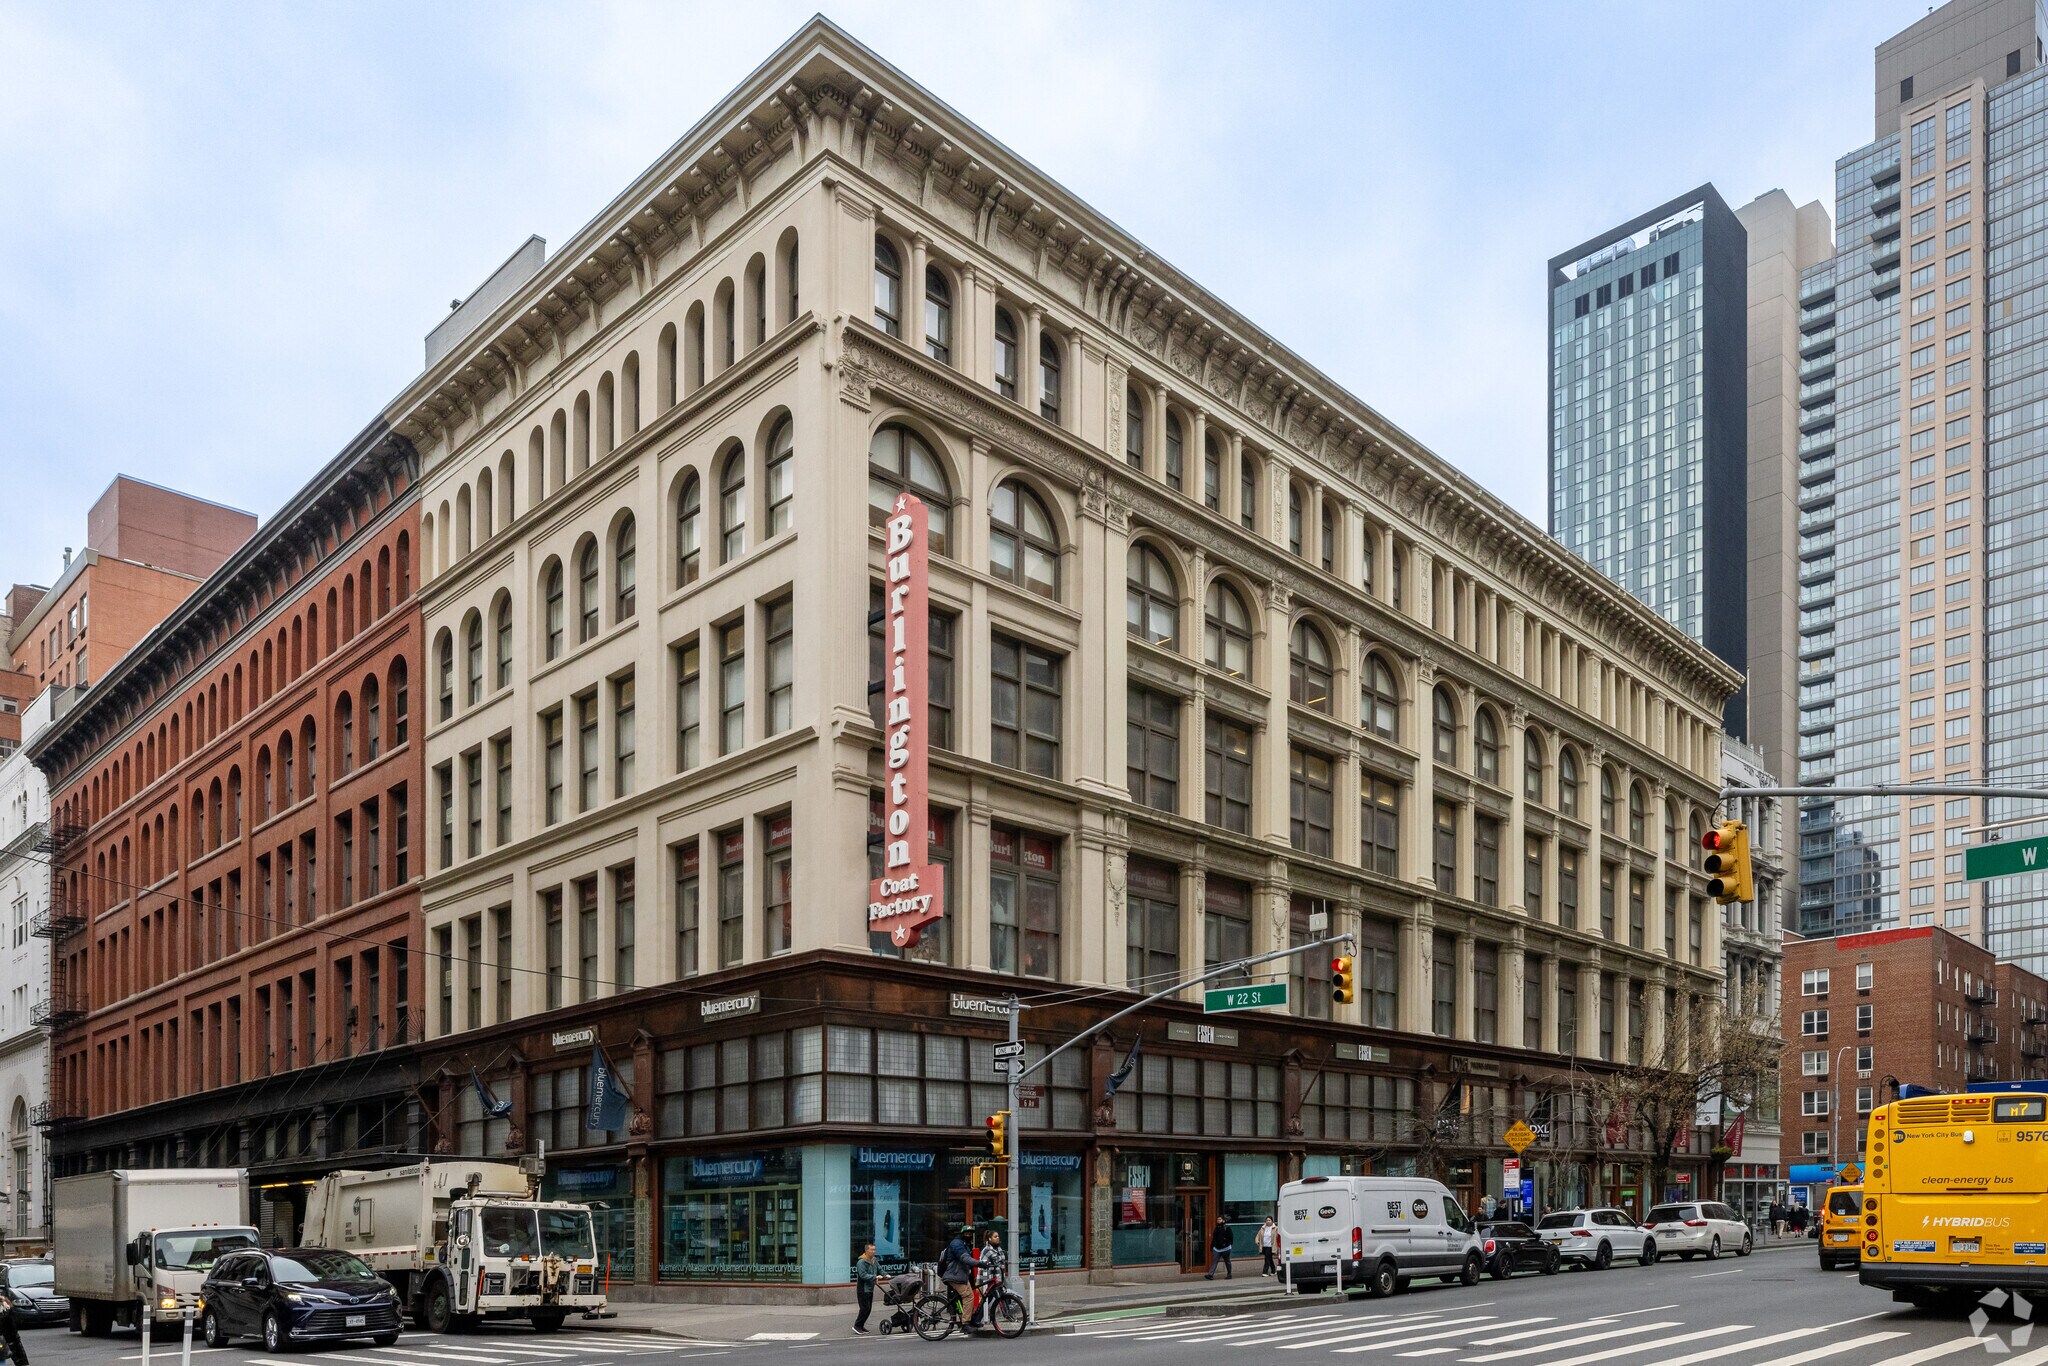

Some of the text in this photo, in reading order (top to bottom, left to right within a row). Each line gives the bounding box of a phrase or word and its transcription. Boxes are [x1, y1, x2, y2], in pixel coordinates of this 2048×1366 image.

[887, 514, 914, 868] Burlington
[880, 873, 919, 897] Coat
[869, 894, 933, 921] Factory
[701, 995, 756, 1016] bluemercury
[1227, 992, 1261, 1006] W 22 St
[552, 1029, 594, 1047] bluemercury
[1197, 1024, 1215, 1044] ESSEN
[998, 1046, 1007, 1055] ONE
[860, 1148, 936, 1168] bluemercury
[1021, 1152, 1081, 1169] bluemercury
[400, 1167, 420, 1176] sanitation
[692, 1157, 758, 1180] bluemercury
[1128, 1165, 1151, 1188] ESSEN
[1922, 1176, 2014, 1185] clean-energy bus
[1386, 1201, 1402, 1210] BEST
[1388, 1210, 1401, 1218] BUY
[1413, 1203, 1428, 1211] Geek
[659, 1263, 688, 1274] bluemercury
[720, 1263, 753, 1274] bluemercury
[753, 1263, 788, 1275] bluemercury
[880, 1261, 908, 1272] mercury
